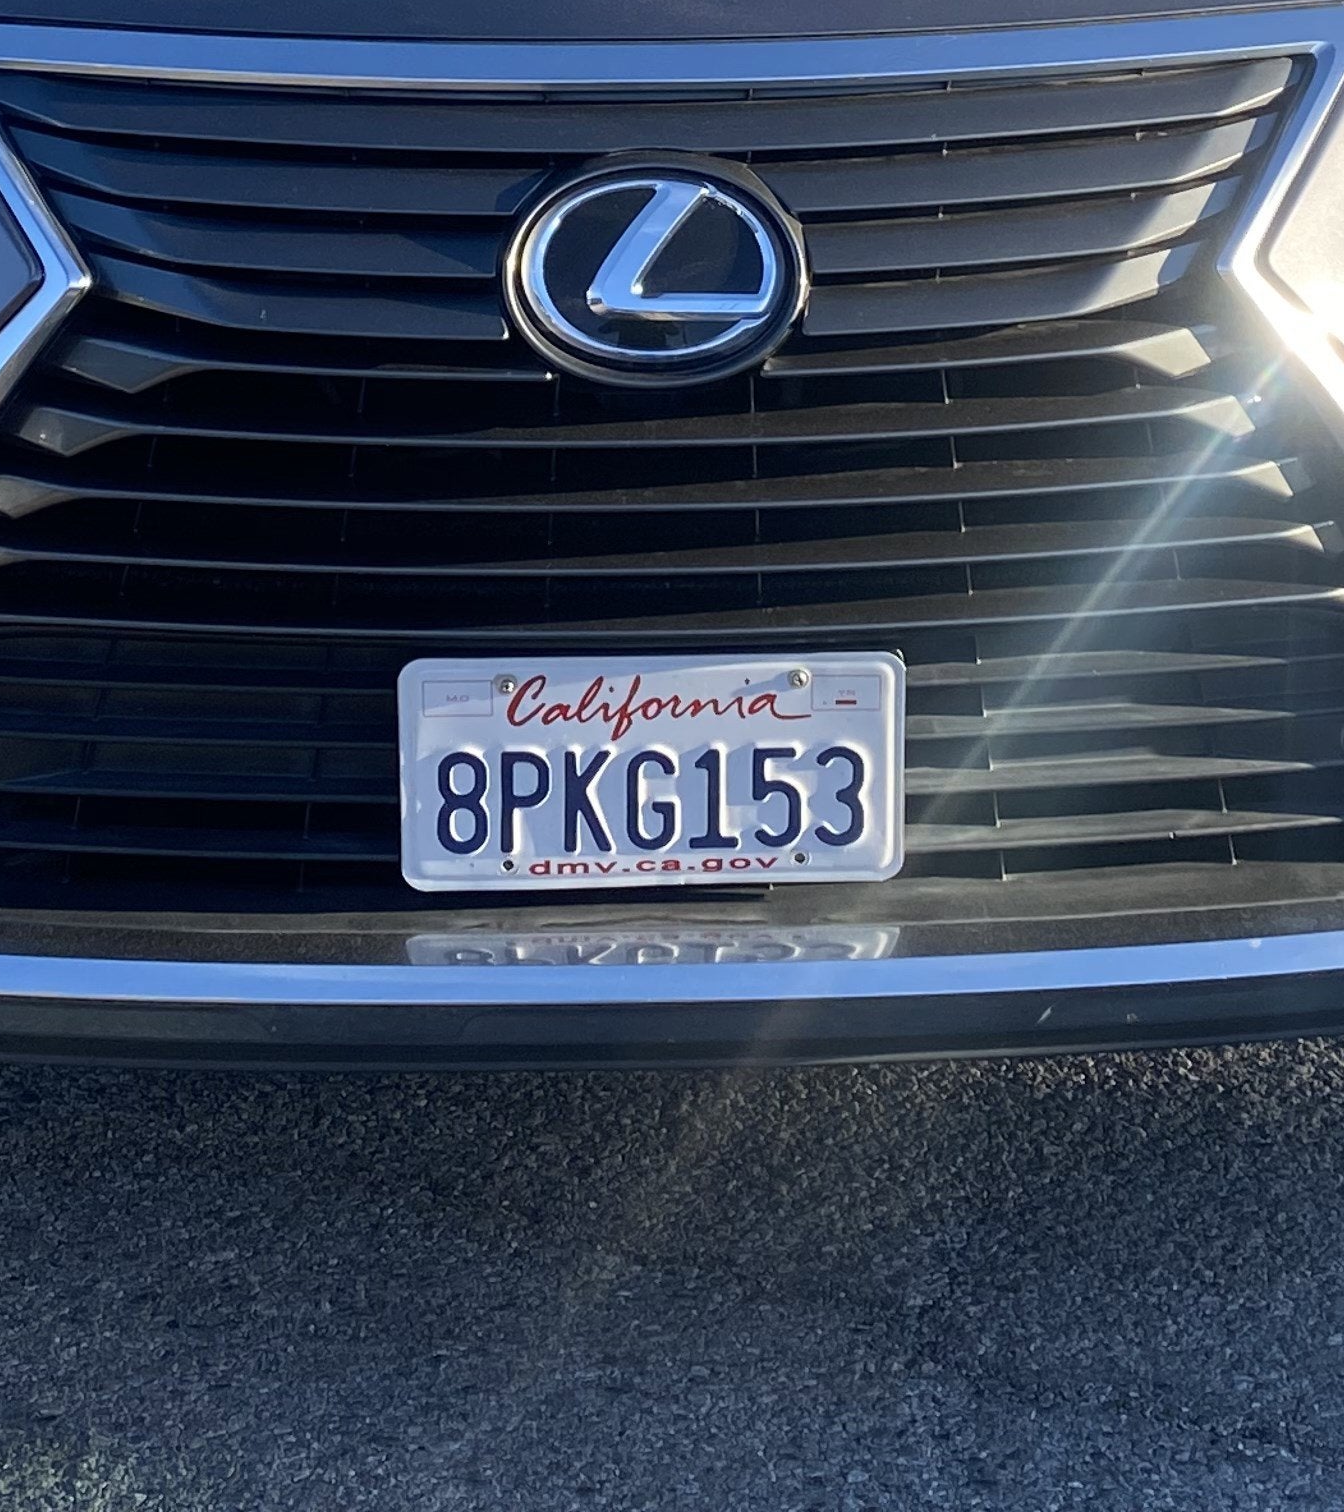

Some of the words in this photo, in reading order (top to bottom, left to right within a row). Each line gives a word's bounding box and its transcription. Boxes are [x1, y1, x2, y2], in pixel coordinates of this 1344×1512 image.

[506, 674, 812, 741] California
[437, 745, 865, 855] 8PKG153
[528, 854, 779, 876] dmv.ca.gov
